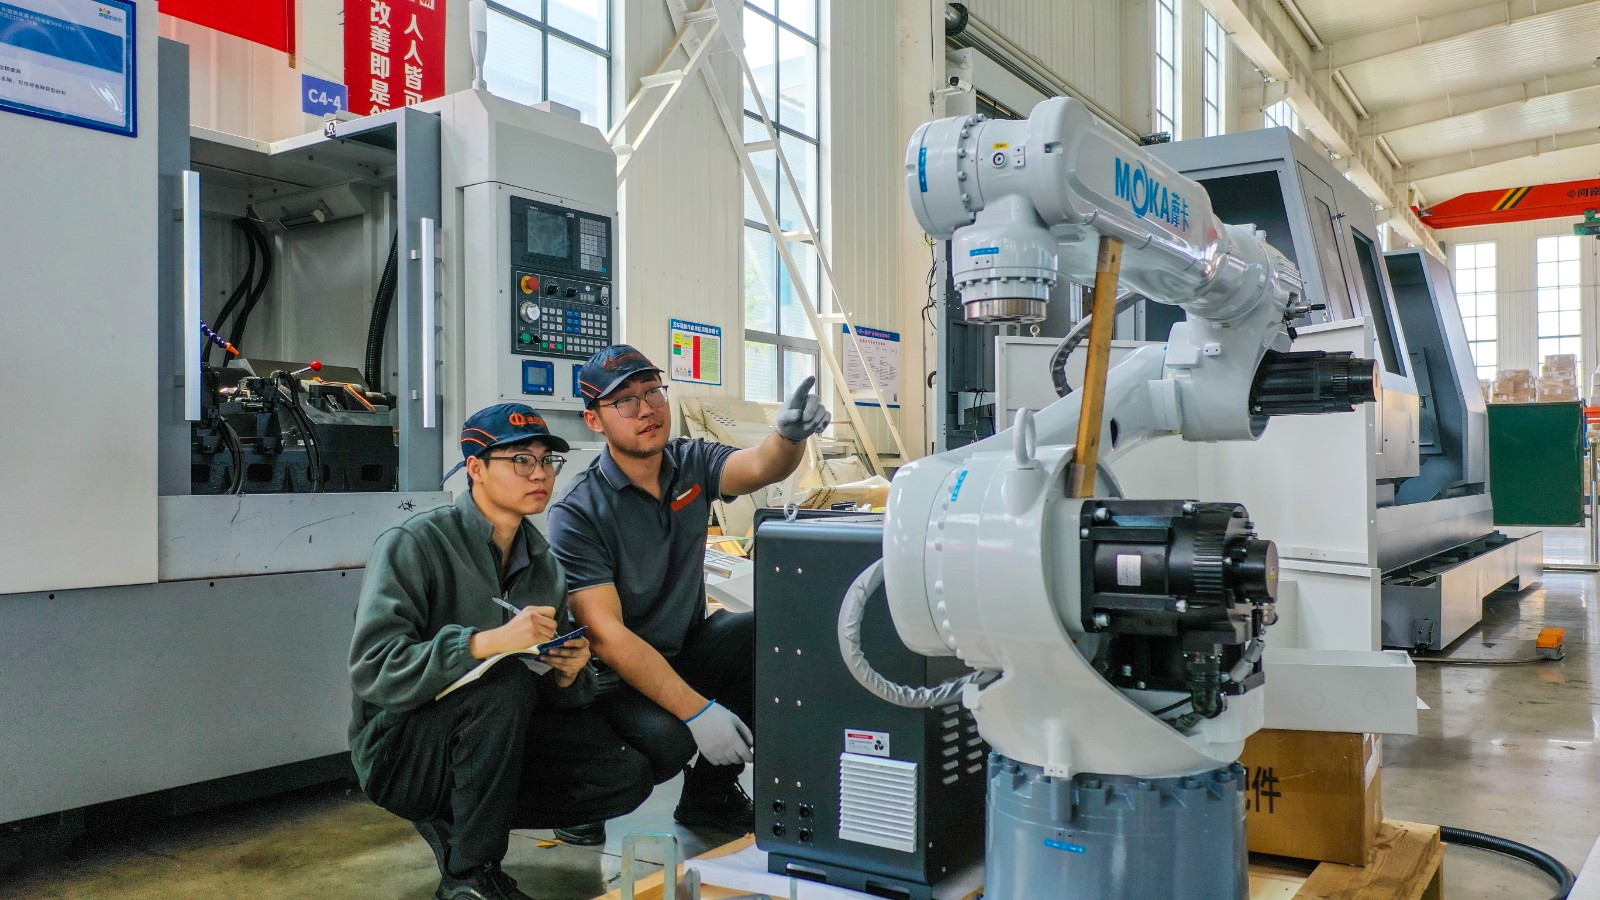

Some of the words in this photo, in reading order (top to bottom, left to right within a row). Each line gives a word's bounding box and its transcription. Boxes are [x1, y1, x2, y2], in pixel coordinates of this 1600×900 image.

[404, 14, 424, 107] 人人皆可
[308, 88, 342, 111] C4-4
[1115, 157, 1170, 223] MOKA
[1245, 766, 1282, 814] 件
